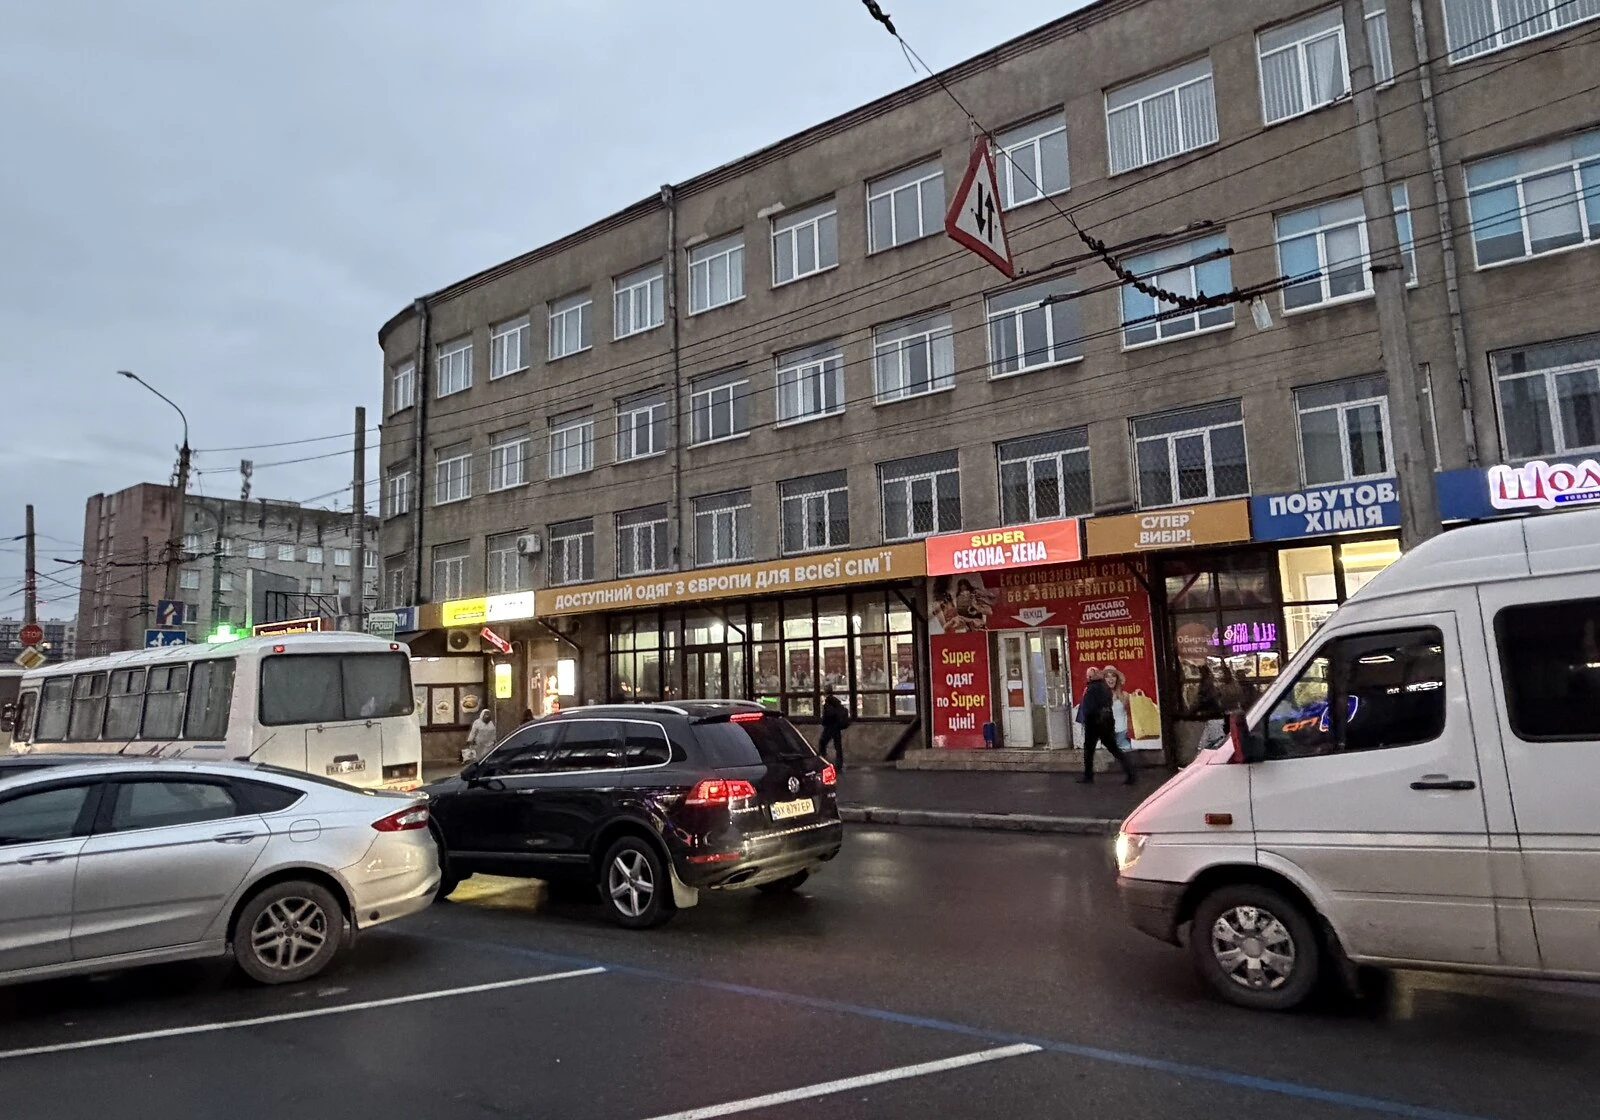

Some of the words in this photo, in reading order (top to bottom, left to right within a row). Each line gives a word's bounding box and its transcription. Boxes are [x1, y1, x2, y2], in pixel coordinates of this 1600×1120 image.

[1269, 482, 1400, 517] ПОБУТОВ
[1141, 513, 1190, 530] СУПЕР
[1304, 505, 1384, 533] ХІМІЯ
[971, 530, 1026, 548] SUPER
[1139, 528, 1192, 545] ВИБІР!
[953, 541, 1048, 570] СЕКОНД-ХЕНД
[554, 584, 633, 610] ДОСТУПНИЙ
[635, 582, 673, 600] ОДЯГ
[675, 582, 685, 595] З
[687, 573, 752, 594] ЄВРОПИ
[755, 568, 790, 589] ДЛЯ
[794, 557, 842, 582] ВСІЄЇ
[1023, 609, 1044, 620] ВХІД
[1082, 608, 1130, 621] ПРОСИМО!
[1084, 600, 1125, 612] ЛАСКАВО
[941, 648, 976, 667] Super
[945, 672, 975, 688] одяг
[936, 696, 949, 708] по
[951, 691, 986, 711] Super
[948, 712, 976, 732] ціні!
